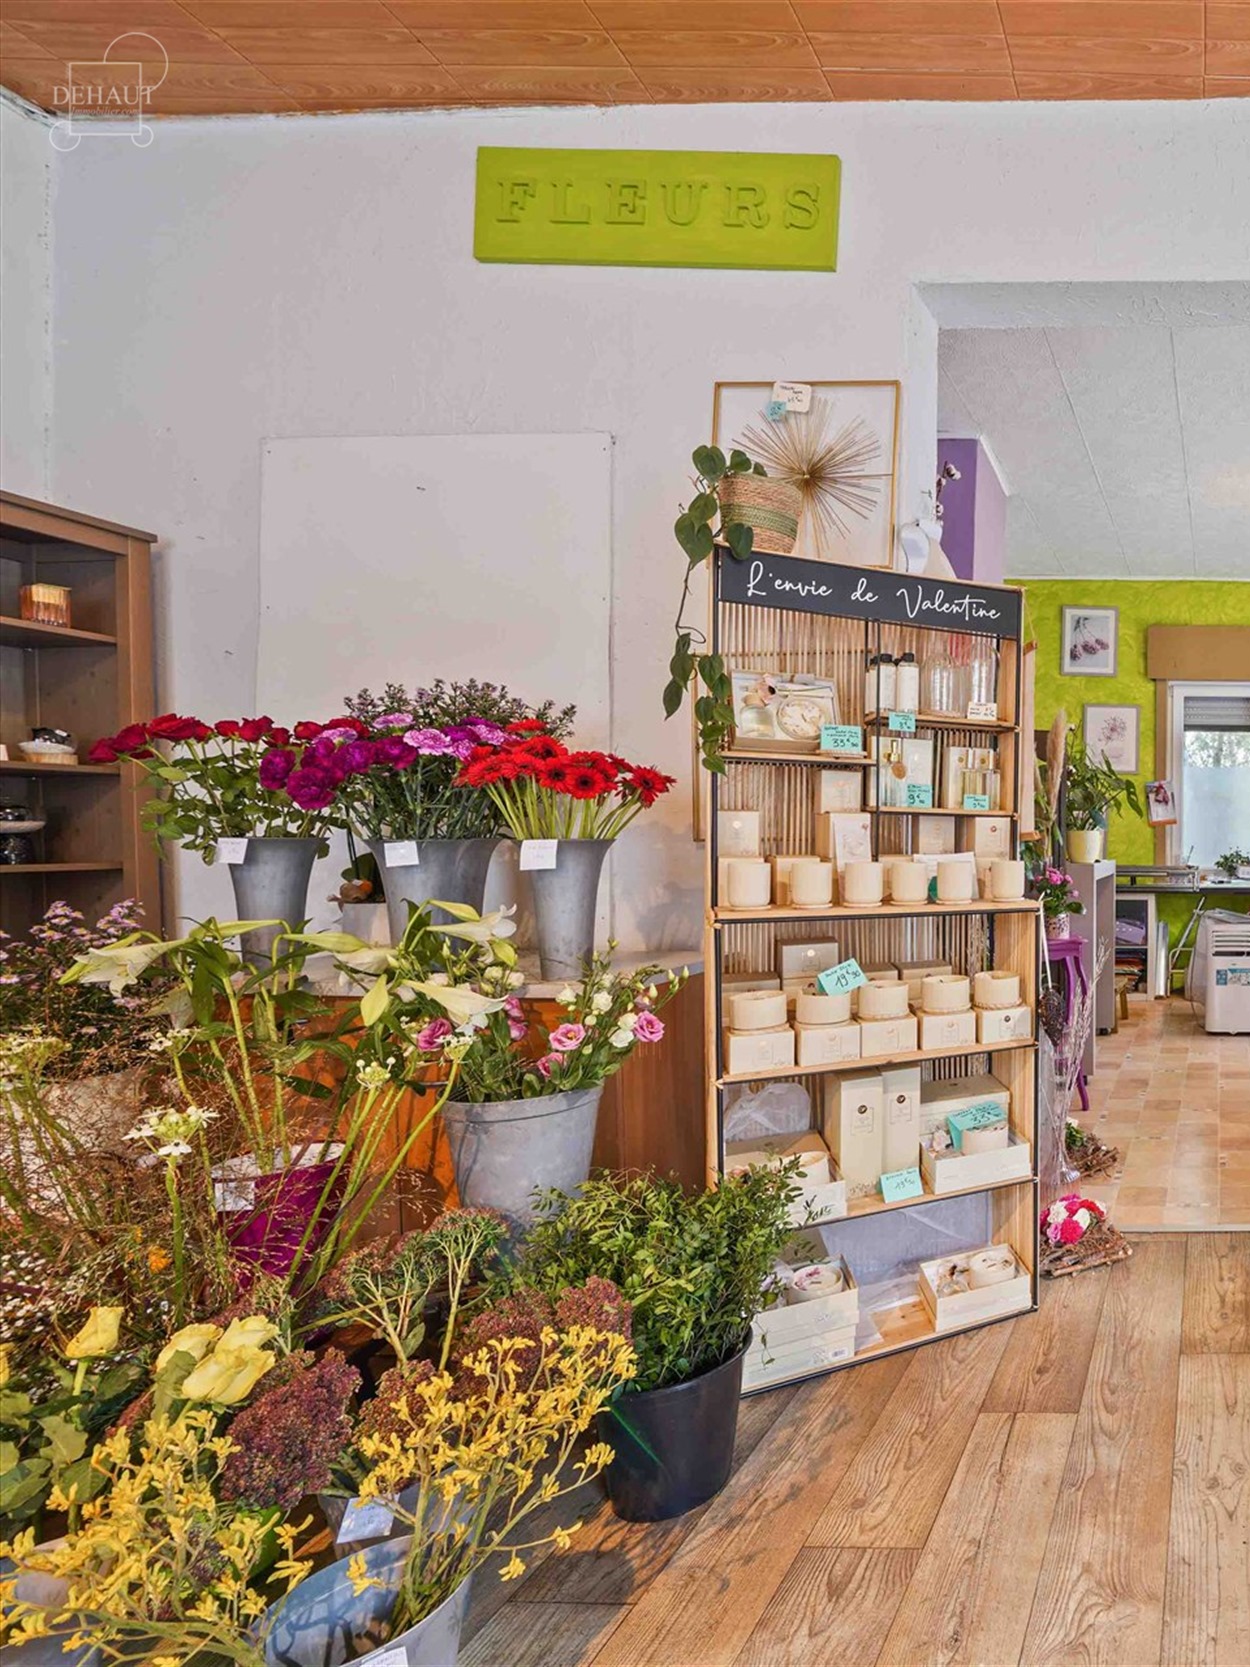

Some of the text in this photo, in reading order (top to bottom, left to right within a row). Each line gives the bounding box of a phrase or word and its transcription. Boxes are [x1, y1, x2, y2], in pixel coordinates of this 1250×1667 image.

[496, 178, 820, 230] FLEURS
[747, 560, 1001, 621] L'envie de Valentine
